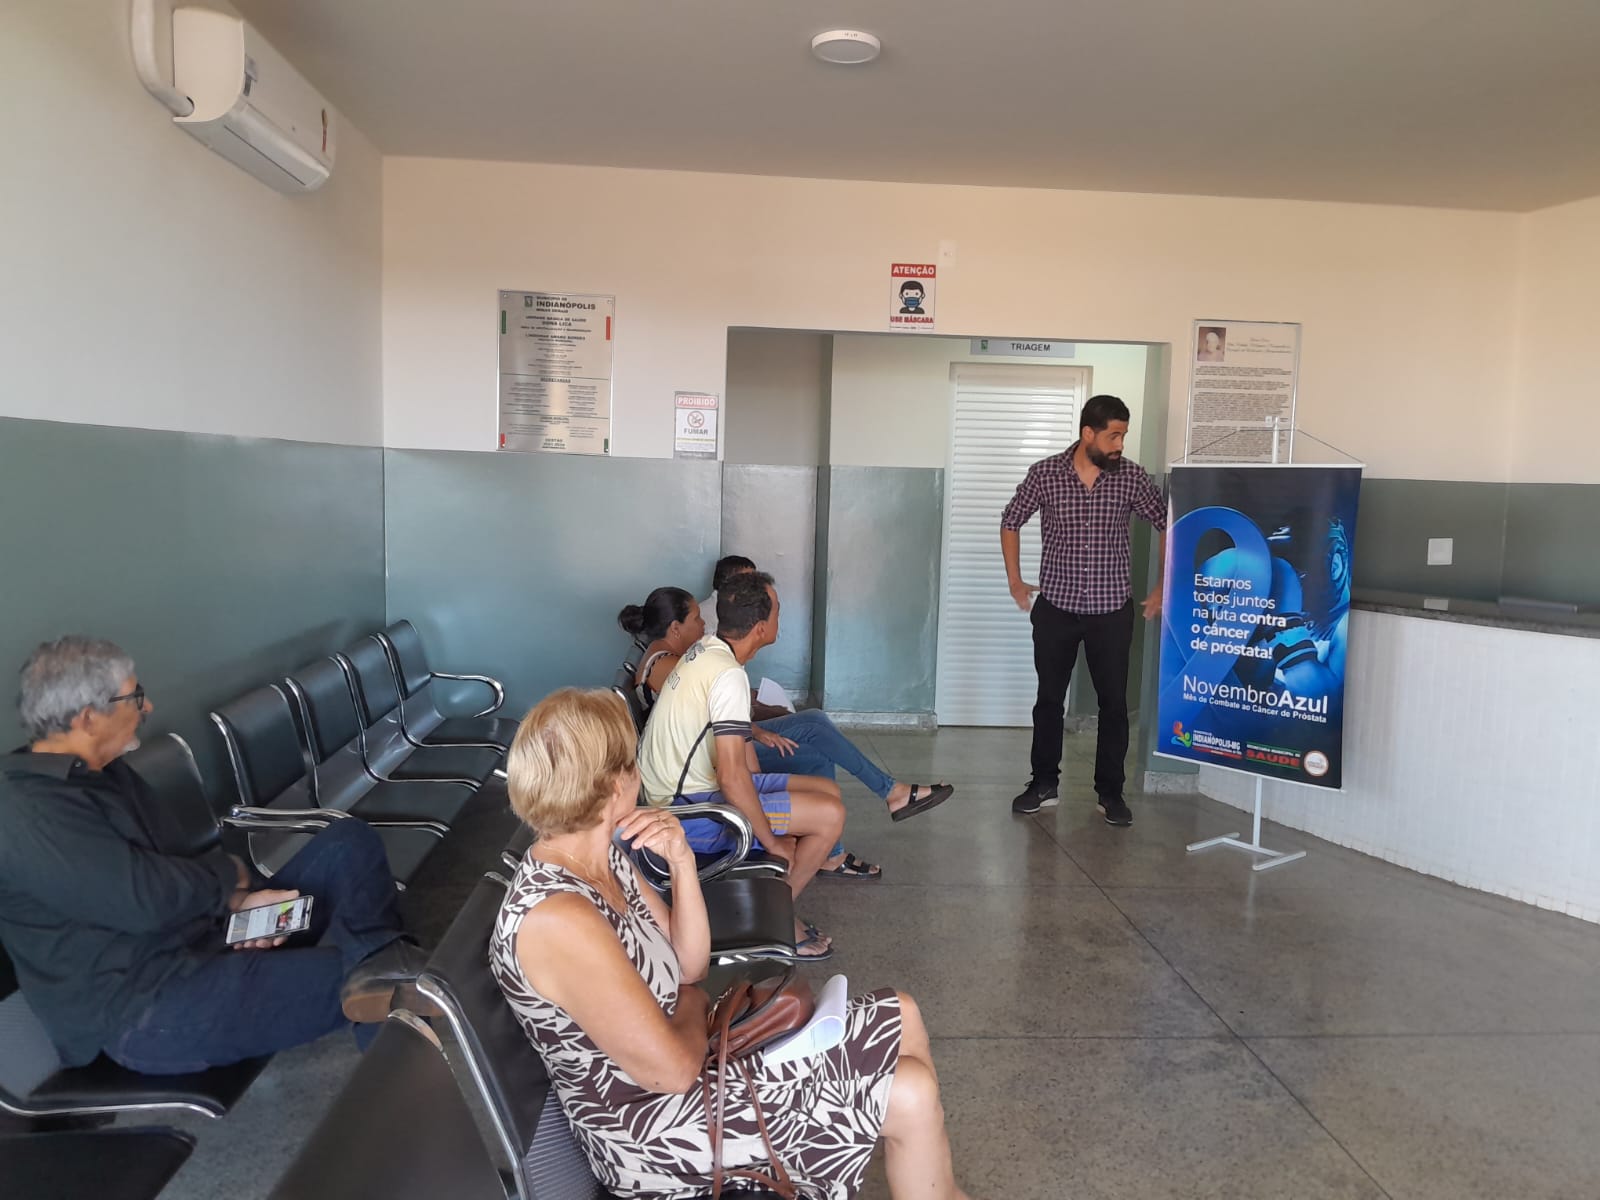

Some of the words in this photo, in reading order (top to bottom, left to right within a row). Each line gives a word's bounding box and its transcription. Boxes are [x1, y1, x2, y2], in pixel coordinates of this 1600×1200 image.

[893, 265, 934, 276] ATENÇÃO
[536, 301, 596, 310] INDIANÓPOLIS
[904, 315, 934, 324] MÁSCARA
[1010, 342, 1051, 352] TRIAGEM
[677, 396, 716, 406] PROIBIDO
[684, 428, 709, 436] FUMAR
[1194, 573, 1252, 590] Estamos
[1193, 590, 1230, 605] todos
[1231, 592, 1276, 610] juntos
[1192, 607, 1209, 619] na
[1211, 606, 1237, 622] luta
[1239, 612, 1287, 628] contra
[1191, 625, 1201, 634] o
[1202, 623, 1250, 639] câncer
[1190, 639, 1208, 651] de
[1210, 640, 1273, 660] próstata!
[1183, 693, 1198, 702] Mês
[1198, 695, 1208, 704] de
[1208, 696, 1240, 710] Combate
[1241, 703, 1251, 711] ao
[1252, 703, 1279, 717] Câncer
[1280, 708, 1291, 718] de
[1292, 711, 1327, 724] Próstata
